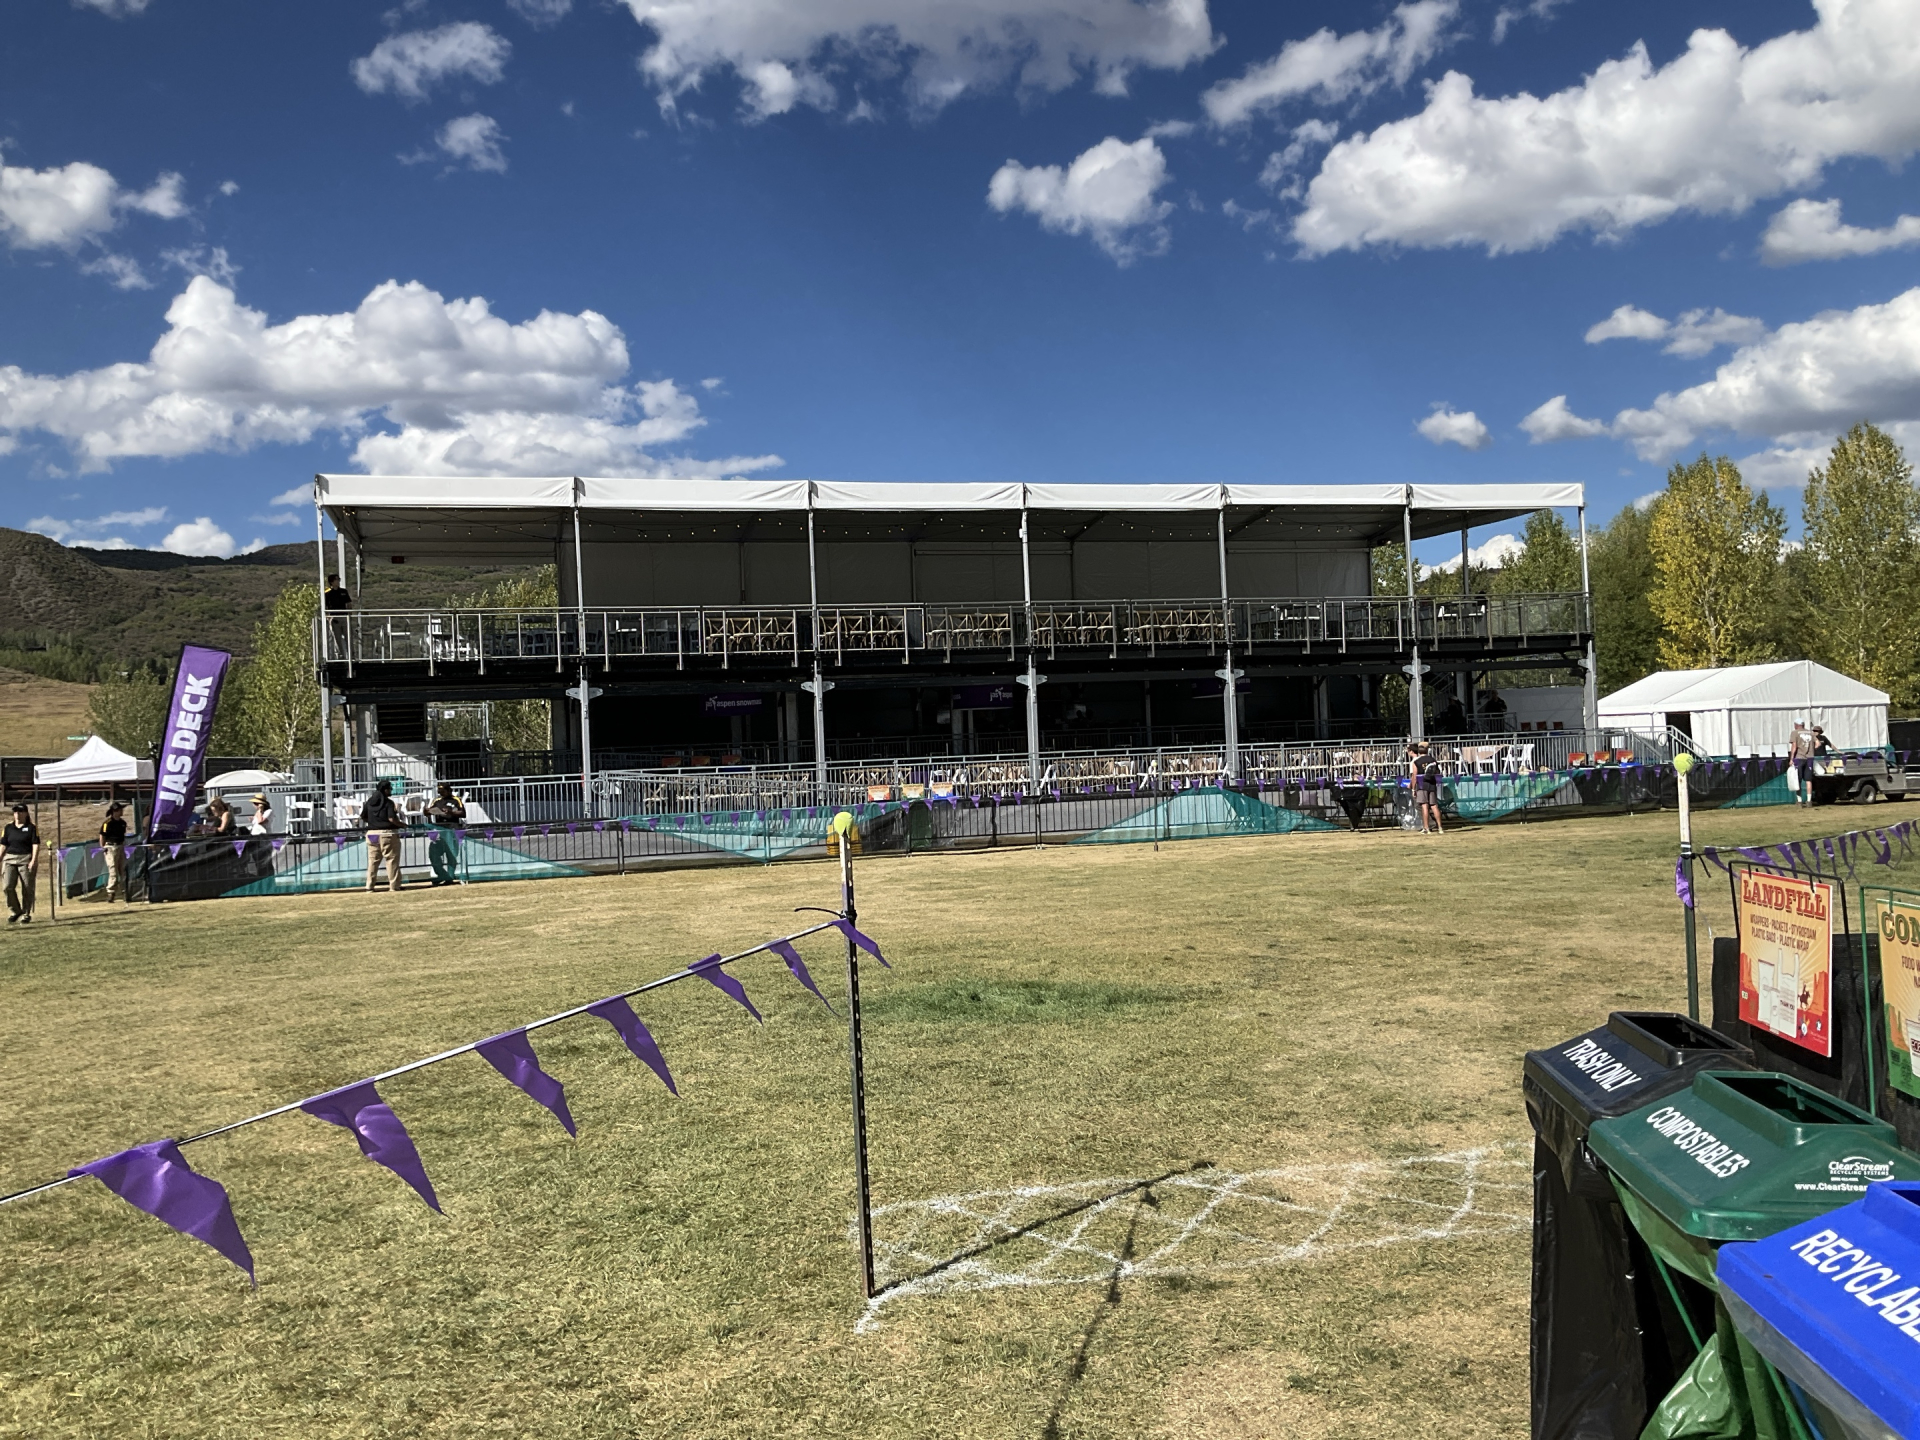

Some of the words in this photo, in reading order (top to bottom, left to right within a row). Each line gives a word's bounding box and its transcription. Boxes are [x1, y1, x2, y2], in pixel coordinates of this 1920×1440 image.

[171, 673, 213, 750] DECK
[716, 700, 735, 708] aspen
[159, 754, 193, 807] JAS
[1743, 880, 1827, 921] LANDFILL
[1751, 926, 1766, 941] PLASTIC
[1780, 934, 1796, 949] PLASTIC
[1562, 1038, 1616, 1074] TRASH
[1590, 1062, 1642, 1092] ONLY
[1646, 1106, 1750, 1178] COMPOSTABLES
[1828, 1161, 1890, 1171] ClearStream
